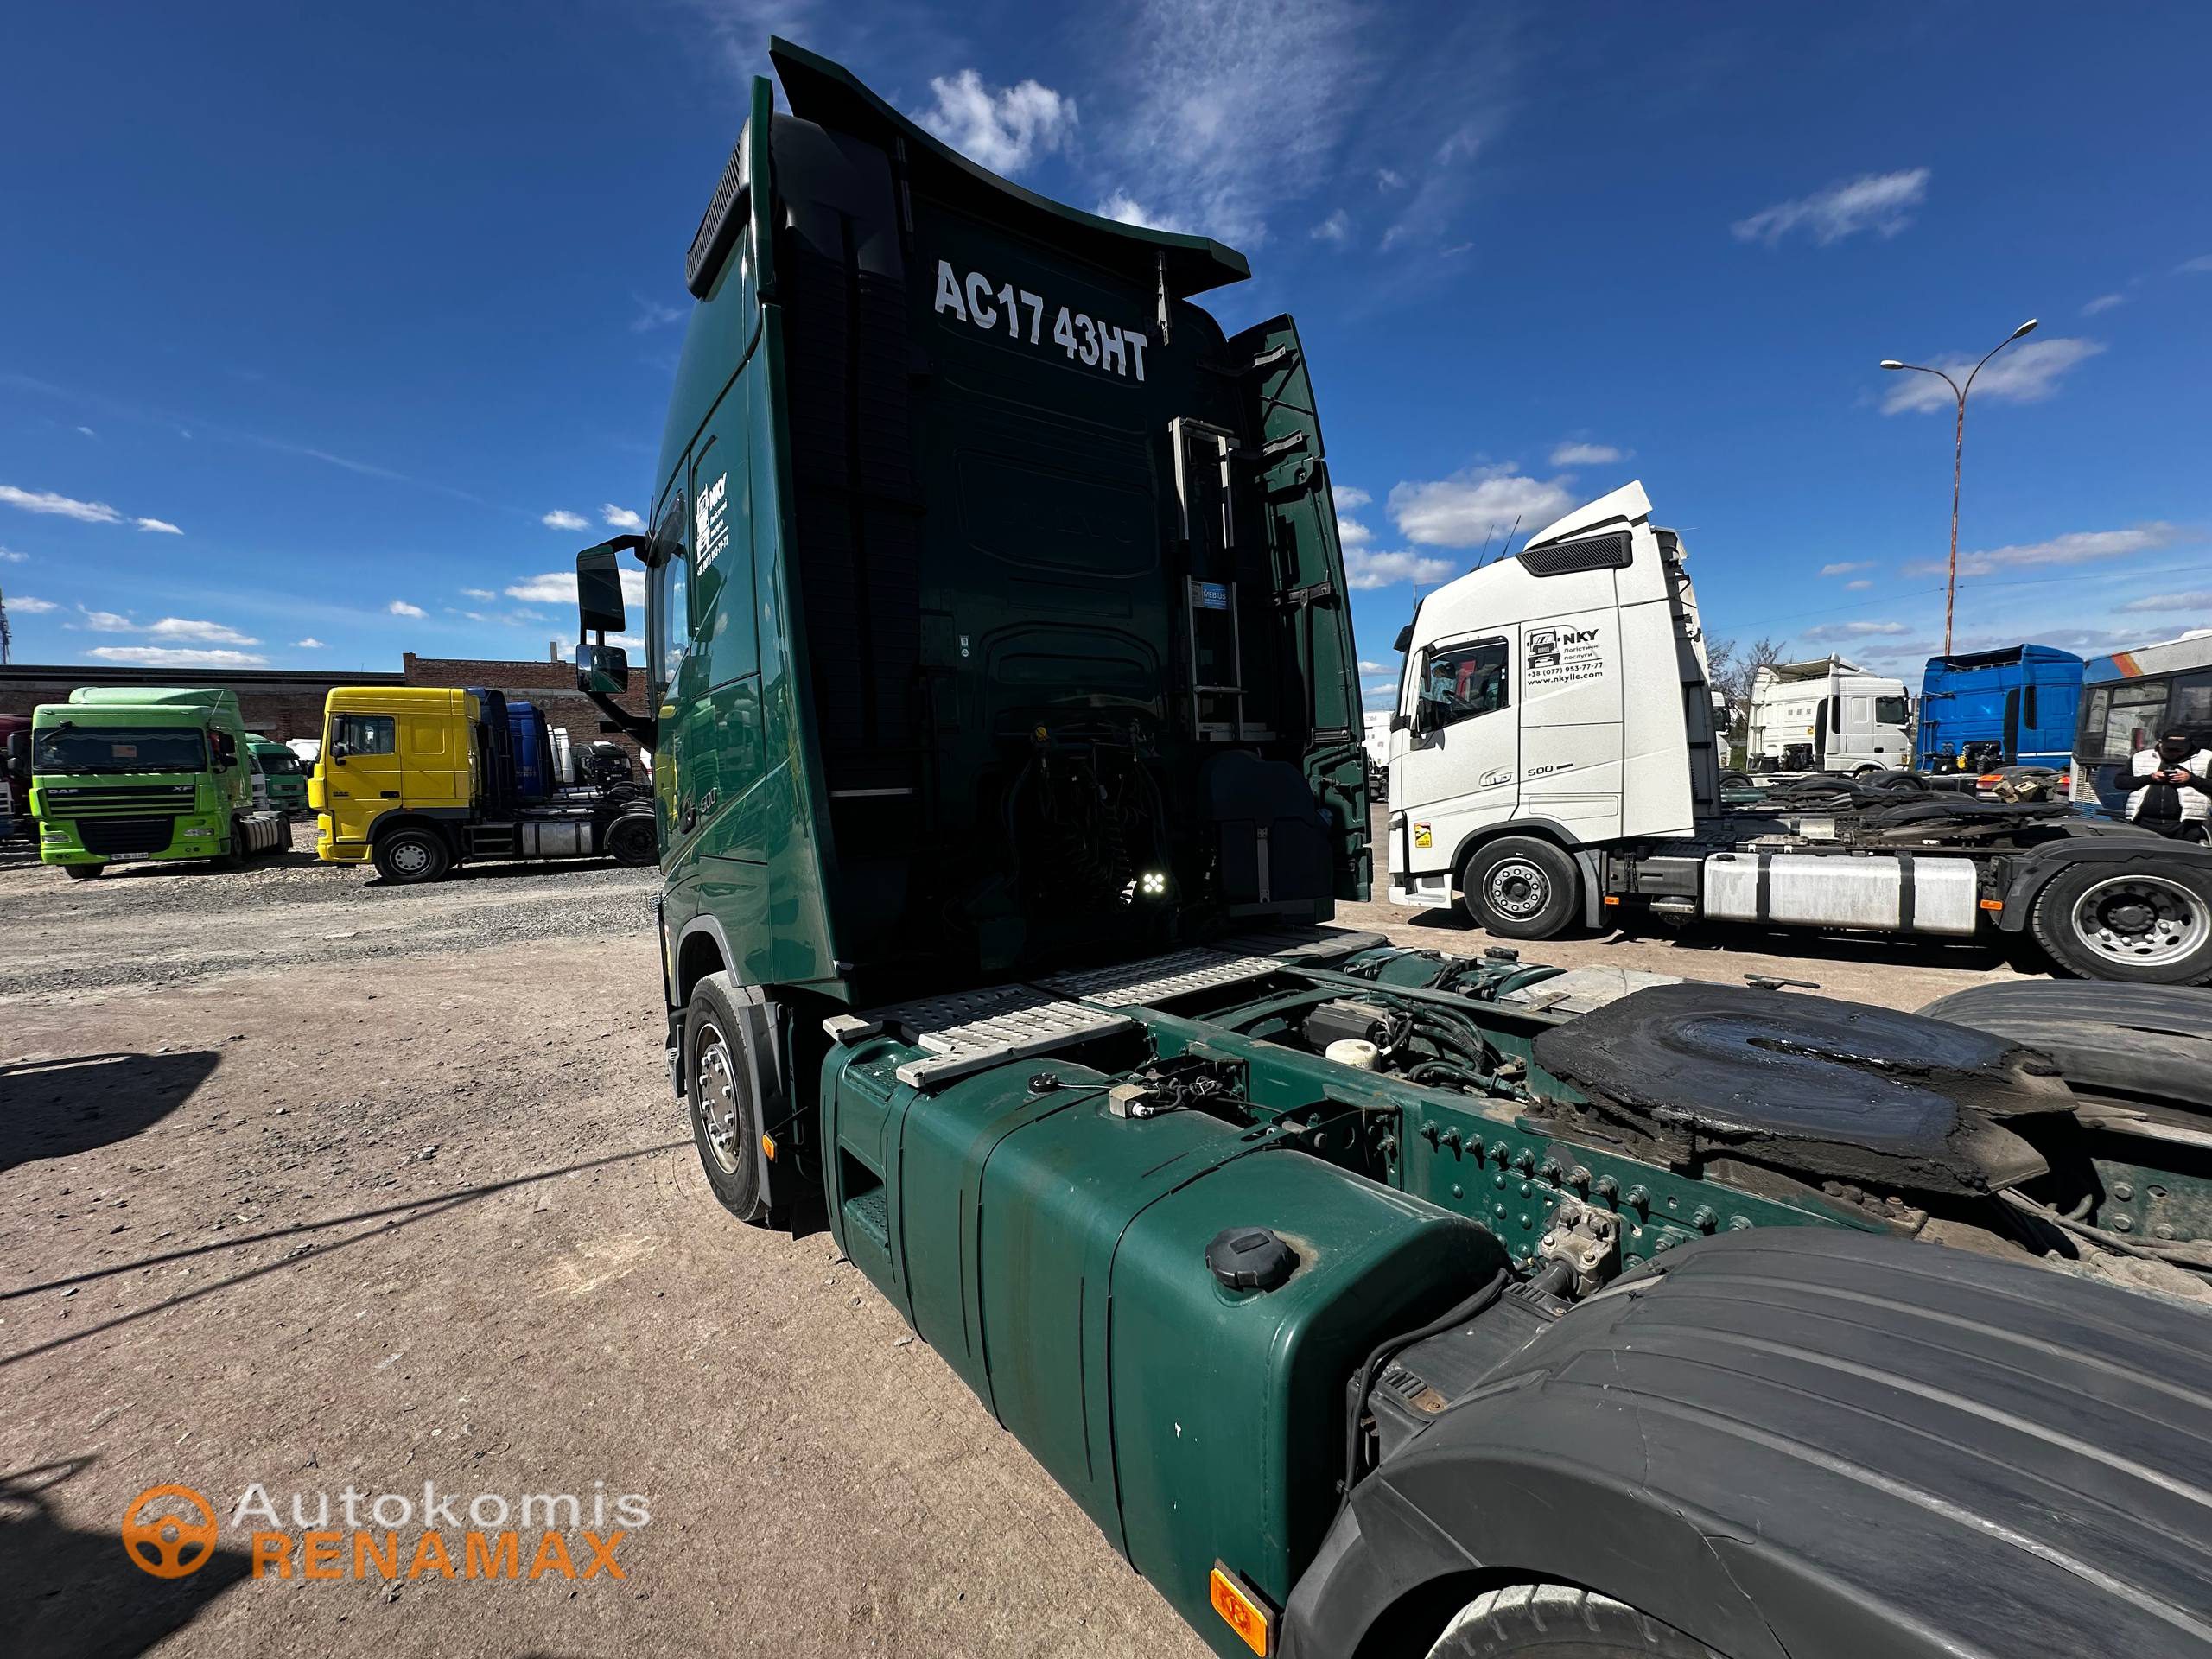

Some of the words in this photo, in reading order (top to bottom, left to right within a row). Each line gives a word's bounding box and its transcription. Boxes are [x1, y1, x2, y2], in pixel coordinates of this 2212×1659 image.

[934, 259, 1043, 345] AC17
[1053, 306, 1147, 381] 43HT
[1563, 628, 1599, 645] NKY
[1565, 662, 1603, 672] 953-77-77
[1527, 671, 1603, 685] www.nkyllc.com
[1528, 765, 1554, 777] 500
